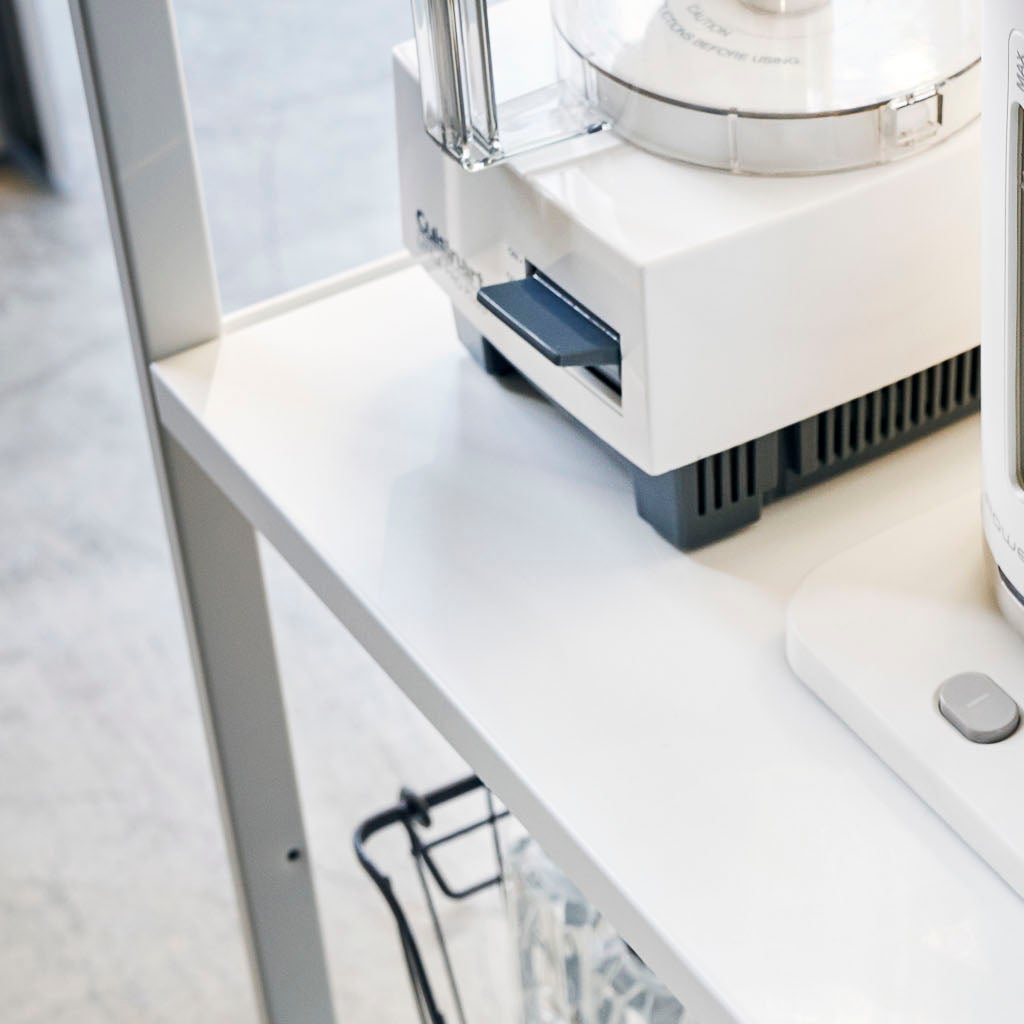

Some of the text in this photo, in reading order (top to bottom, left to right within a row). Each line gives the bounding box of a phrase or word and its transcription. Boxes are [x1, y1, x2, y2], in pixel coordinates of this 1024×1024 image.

[687, 3, 730, 37] CAUTION
[693, 37, 748, 62] BEFORE
[1016, 47, 1024, 93] MAX
